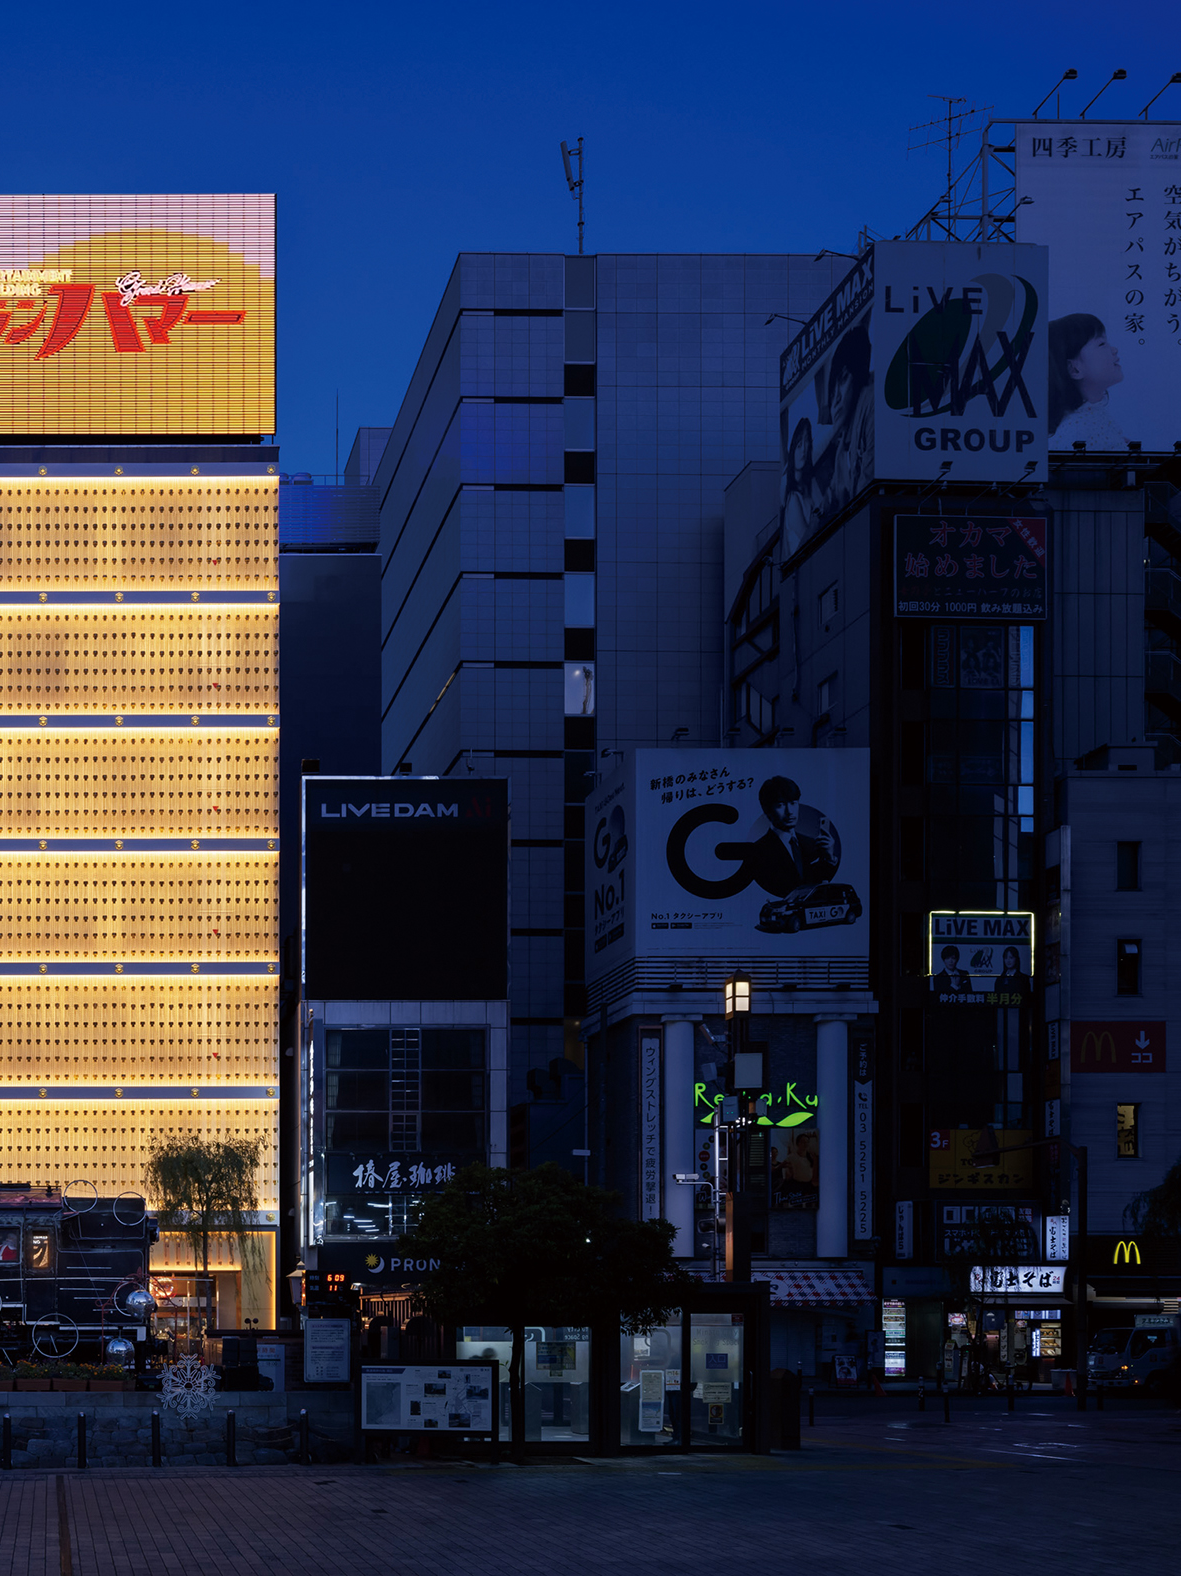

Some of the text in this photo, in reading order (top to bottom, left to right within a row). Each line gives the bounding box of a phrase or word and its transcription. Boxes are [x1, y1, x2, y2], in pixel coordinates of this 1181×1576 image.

[1032, 136, 1127, 159] 四季工房
[1125, 187, 1146, 346] エアパスの家。
[835, 254, 874, 318] MAX
[910, 331, 1038, 418] MAX
[914, 427, 1034, 452] GROUP
[929, 520, 1013, 548] オカマ
[904, 552, 1038, 579] 始めました
[898, 600, 1044, 615] 初回30分 1000円 飲み放題込み
[650, 766, 730, 791] 新橋のみなさん
[651, 912, 723, 920] No.1 タクシーアプリ
[983, 919, 1029, 936] MAX
[986, 992, 1023, 1005] 半月分
[1131, 1051, 1153, 1064] ココ
[938, 1172, 1024, 1185] ジンギスカン
[390, 1257, 441, 1272] PRON
[708, 1354, 726, 1364] 入口
